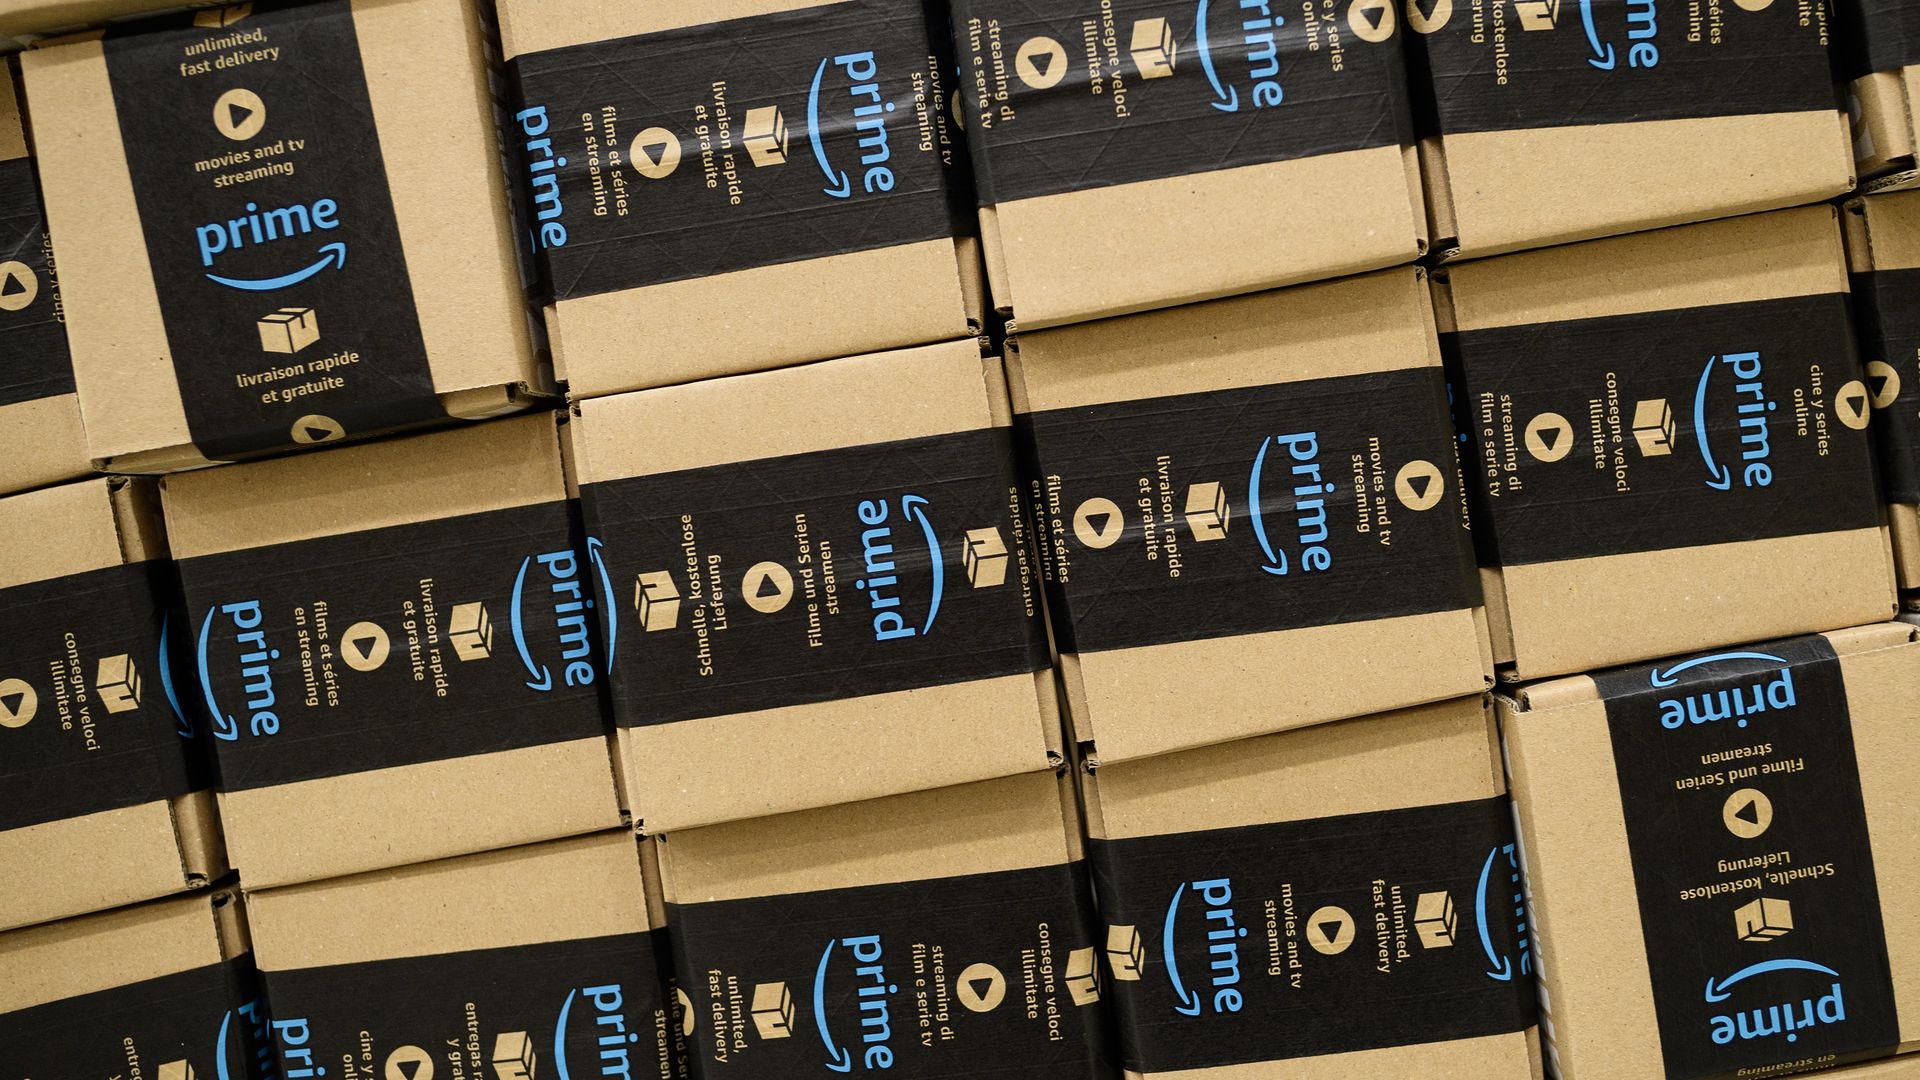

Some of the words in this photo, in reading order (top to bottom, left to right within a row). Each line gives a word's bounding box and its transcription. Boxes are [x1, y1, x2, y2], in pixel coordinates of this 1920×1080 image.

[968, 18, 981, 51] film
[1303, 2, 1320, 50] online
[1322, 13, 1335, 21] y
[1471, 0, 1484, 43] erung
[1815, 0, 1829, 46] apide
[180, 60, 211, 76] fast
[215, 47, 279, 69] delivery
[185, 28, 267, 56] unlimited,
[974, 56, 982, 65] e
[1083, 20, 1103, 94] illimitate
[1101, 0, 1119, 66] onsegne
[1111, 70, 1131, 118] veloci
[1238, 0, 1284, 107] rime
[1327, 26, 1344, 71] series
[1493, 0, 1509, 84] kostenlose
[927, 56, 943, 116] movies
[975, 70, 991, 108] serie
[988, 20, 1009, 100] streaming
[1001, 106, 1015, 120] di
[582, 113, 593, 131] en
[602, 106, 617, 146] films
[695, 105, 708, 121] et
[712, 81, 738, 149] livraison
[834, 51, 896, 194] prime
[906, 73, 933, 151] streaming
[937, 116, 951, 144] and
[981, 112, 992, 128] tv
[195, 152, 251, 171] movies
[254, 140, 284, 158] and
[288, 140, 304, 151] tv
[214, 162, 294, 187] streaming
[517, 106, 567, 249] prime
[586, 137, 608, 215] streaming
[609, 151, 621, 166] et
[695, 125, 718, 188] gratuite
[942, 150, 951, 165] tv
[612, 171, 629, 216] séries
[723, 154, 743, 204] rapide
[196, 199, 339, 266] prime
[237, 365, 304, 387] livraison
[309, 351, 359, 371] rapide
[262, 390, 278, 403] et
[282, 377, 344, 402] gratuite
[1811, 365, 1823, 395] cine
[1481, 392, 1494, 422] film
[1723, 352, 1776, 486] prime
[1794, 389, 1808, 435] online
[1811, 400, 1823, 408] y
[1484, 428, 1493, 436] e
[1501, 395, 1518, 471] streaming
[1589, 399, 1606, 468] illimitate
[1606, 373, 1622, 442] consegne
[1615, 448, 1630, 491] veloci
[1816, 413, 1830, 456] series
[1369, 438, 1385, 491] movies
[1485, 441, 1500, 476] serie
[1031, 479, 1041, 498] en
[1047, 475, 1061, 514] films
[1139, 478, 1151, 493] et
[1157, 456, 1177, 525] livraison
[1278, 432, 1334, 571] prime
[1352, 455, 1371, 532] streaming
[1490, 482, 1500, 496] tv
[1509, 477, 1522, 490] di
[1009, 487, 1023, 544] rápidas
[1052, 519, 1064, 534] et
[1138, 498, 1159, 560] gratuite
[1376, 496, 1392, 525] and
[682, 515, 702, 599] kostenlose
[795, 514, 811, 563] Serien
[1164, 528, 1182, 577] rapide
[1380, 529, 1391, 546] tv
[820, 541, 839, 614] streamen
[856, 500, 915, 640] prime
[1017, 549, 1033, 616] entregas
[1055, 539, 1070, 583] séries
[708, 555, 727, 630] Lieferung
[799, 569, 815, 598] und
[295, 608, 305, 625] en
[314, 601, 328, 639] films
[404, 601, 416, 616] et
[537, 550, 594, 686] prime
[808, 604, 822, 647] Filme
[320, 644, 332, 659] et
[403, 621, 425, 680] gratuite
[420, 579, 438, 643] livraison
[430, 649, 448, 696] rapide
[692, 605, 713, 675] Schnelle,
[222, 600, 279, 736] prime
[298, 630, 319, 706] streaming
[323, 663, 339, 706] séries
[50, 660, 72, 730] illimitate
[65, 633, 86, 702] consegne
[80, 707, 100, 750] veloci
[1659, 667, 1796, 730] prime
[1702, 744, 1772, 764] streamen
[1729, 767, 1757, 783] und
[1762, 758, 1804, 773] Filme
[1676, 773, 1724, 789] Serien
[1718, 852, 1790, 872] Lieferung
[1766, 863, 1834, 885] Schnelle,
[1282, 884, 1297, 936] movies
[1372, 879, 1385, 908] fast
[1680, 877, 1762, 900] kostenlose
[1193, 878, 1247, 1012] prime
[1265, 900, 1282, 975] streaming
[1376, 913, 1390, 972] delivery
[1391, 886, 1410, 962] unlimited,
[912, 943, 926, 973] film
[1288, 942, 1302, 968] and
[709, 969, 722, 997] fast
[842, 935, 897, 1069] prime
[932, 946, 950, 1021] streaming
[941, 1027, 954, 1039] di
[1022, 949, 1038, 1018] illimitate
[1039, 923, 1054, 992] consegne
[1047, 997, 1063, 1040] veloci
[1291, 973, 1302, 988] tv
[728, 976, 747, 1052] unlimited,
[917, 992, 932, 1027] serie
[1711, 983, 1845, 1044] prime
[272, 1018, 326, 1079] pri
[359, 1030, 374, 1061] cine
[446, 1038, 460, 1047] y
[465, 1002, 482, 1068] entregas
[582, 984, 638, 1080] prim
[712, 1003, 727, 1062] delivery
[921, 1032, 932, 1046] tv
[123, 1037, 143, 1080] entre
[360, 1065, 374, 1074] y
[448, 1052, 466, 1080] grat
[678, 1055, 689, 1080] Ser
